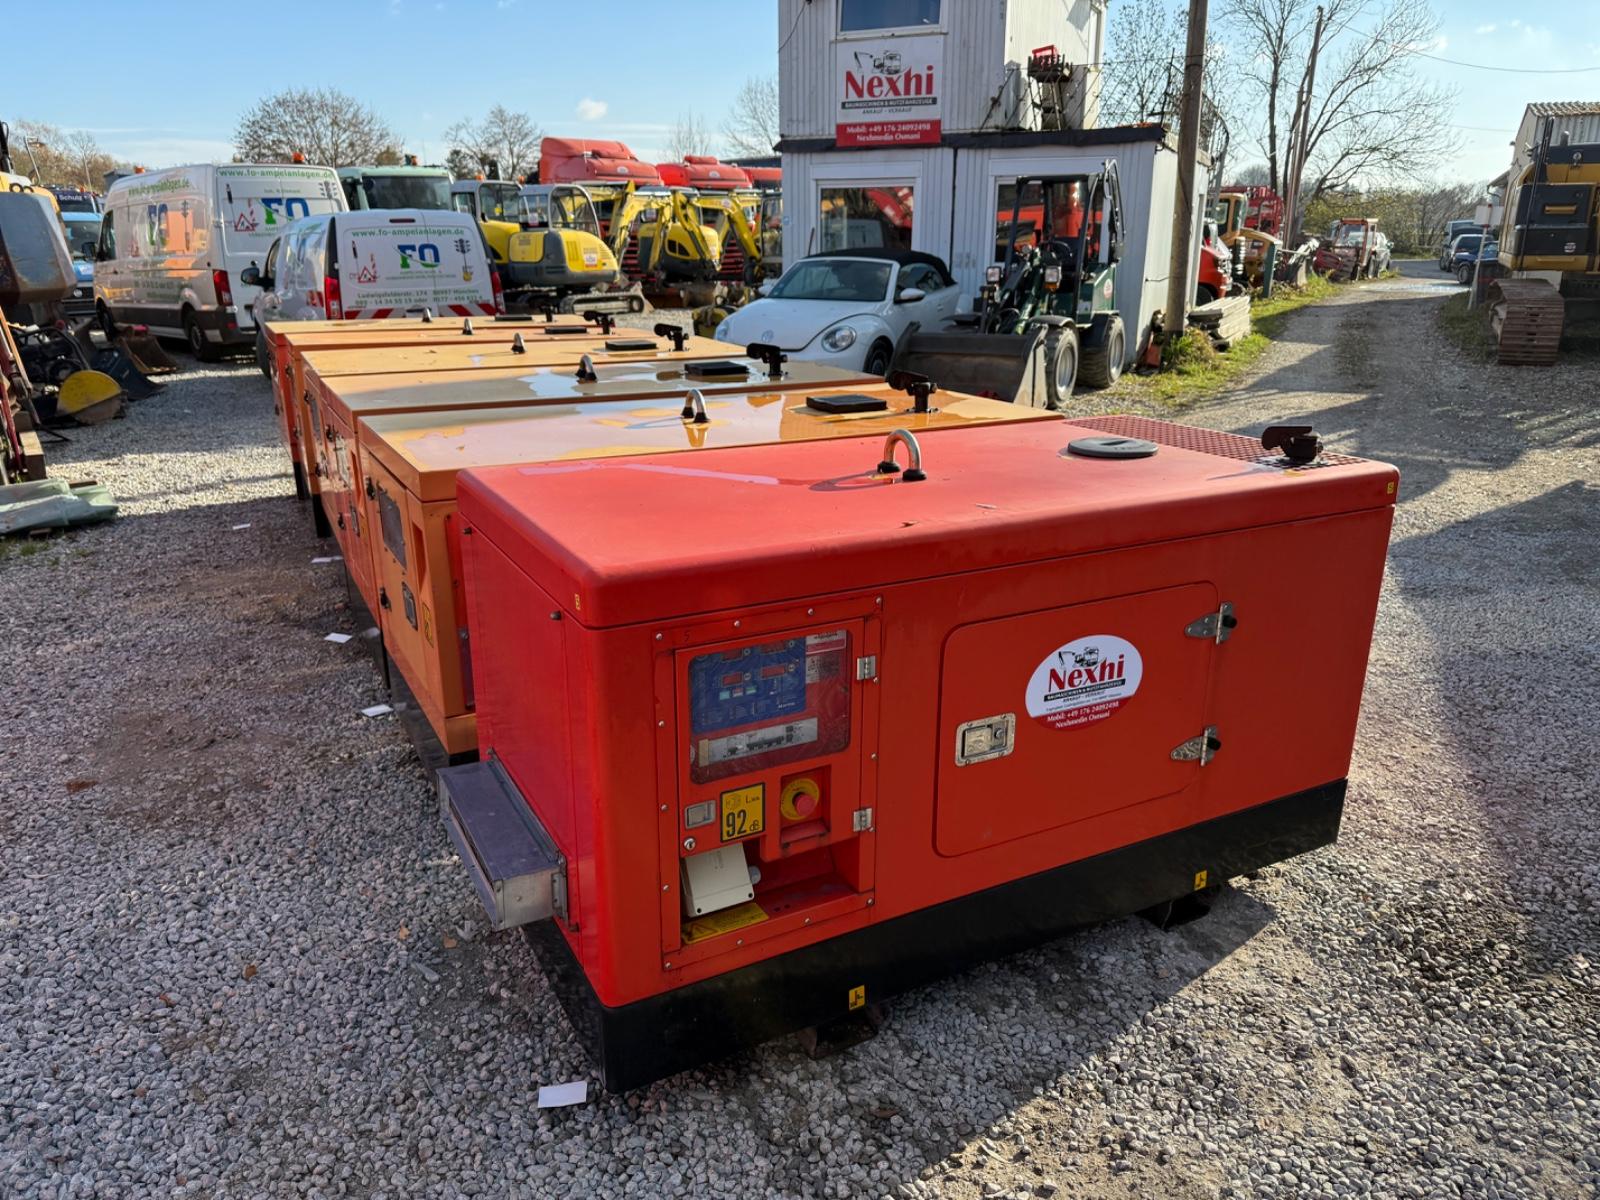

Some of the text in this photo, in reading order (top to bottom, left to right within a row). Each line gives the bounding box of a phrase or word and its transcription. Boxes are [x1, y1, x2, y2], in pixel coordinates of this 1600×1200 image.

[845, 65, 934, 99] Nexhi
[846, 126, 866, 134] Mobil:
[868, 124, 881, 132] +49
[219, 168, 333, 179] www.fo-ampelanlagen.de
[351, 228, 464, 238] www.fo-ampelanlagen.de
[398, 243, 440, 268] FO
[1048, 654, 1125, 692] Nexhi
[1046, 713, 1066, 722] Mobil:
[1067, 711, 1079, 719] +49
[726, 809, 760, 838] 92 dB
